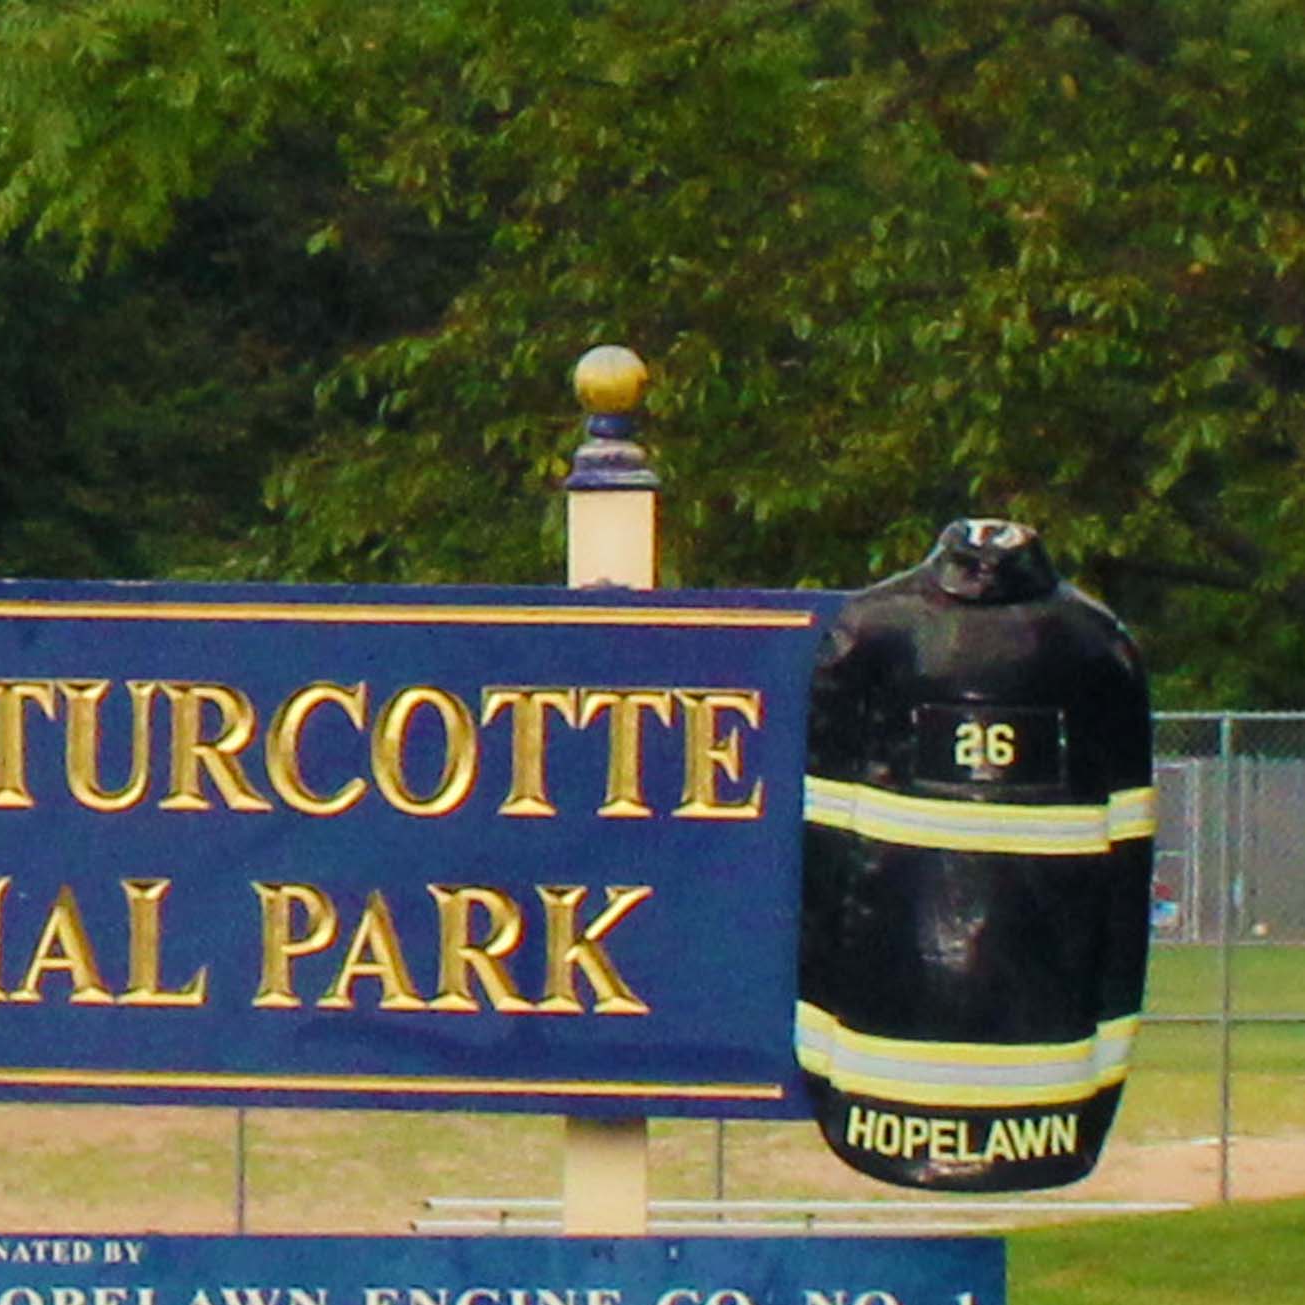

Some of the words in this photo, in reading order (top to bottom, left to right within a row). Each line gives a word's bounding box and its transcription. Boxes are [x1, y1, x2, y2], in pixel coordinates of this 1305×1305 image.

[953, 721, 1016, 766] 26
[250, 880, 653, 1015] PARK
[846, 1104, 1079, 1162] HOPELAWN
[102, 1240, 144, 1266] BY
